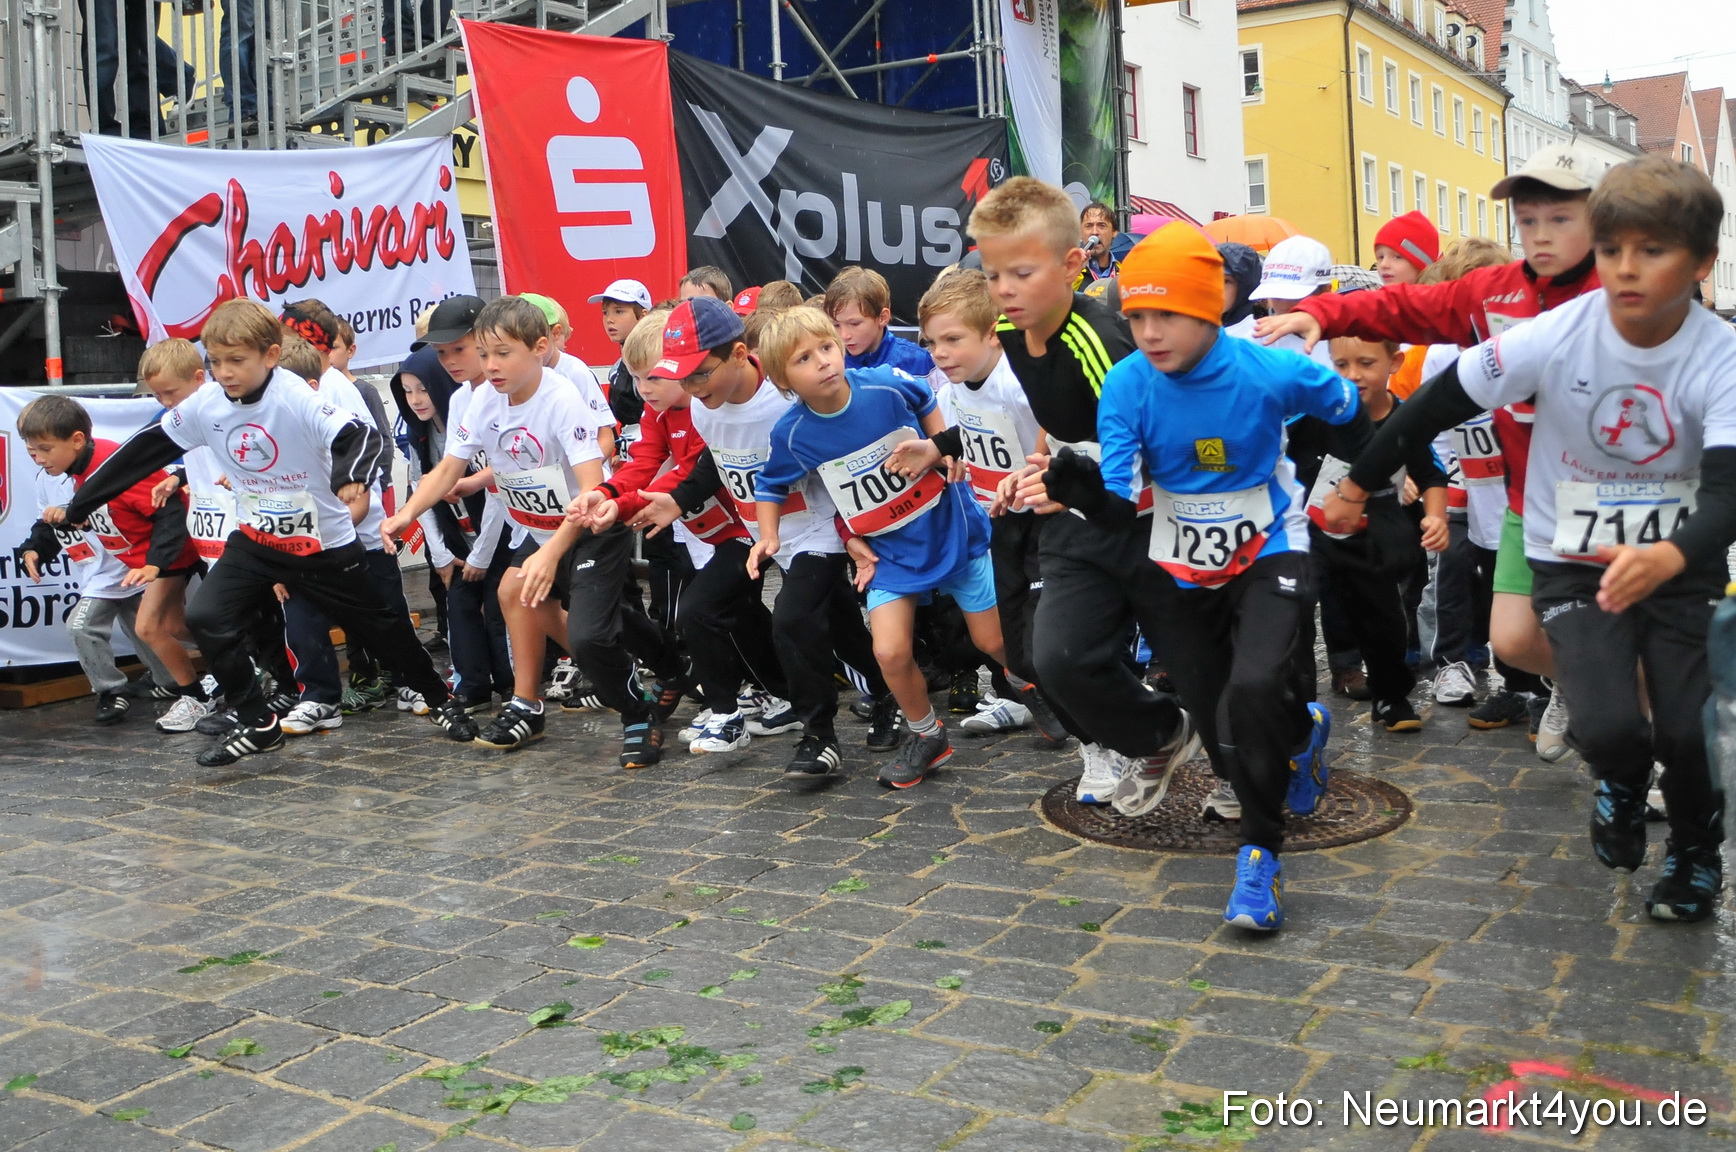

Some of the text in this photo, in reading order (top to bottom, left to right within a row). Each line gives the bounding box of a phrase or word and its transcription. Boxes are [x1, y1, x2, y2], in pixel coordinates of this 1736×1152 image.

[1129, 283, 1168, 295] odlo
[720, 452, 759, 465] BOCK
[847, 443, 889, 472] BOCK
[1597, 481, 1665, 497] BOCK
[259, 499, 294, 510] BOCK
[504, 487, 564, 514] 7034
[1173, 500, 1226, 516] BOCK
[888, 498, 914, 520] Jan
[253, 531, 304, 553] Thomas
